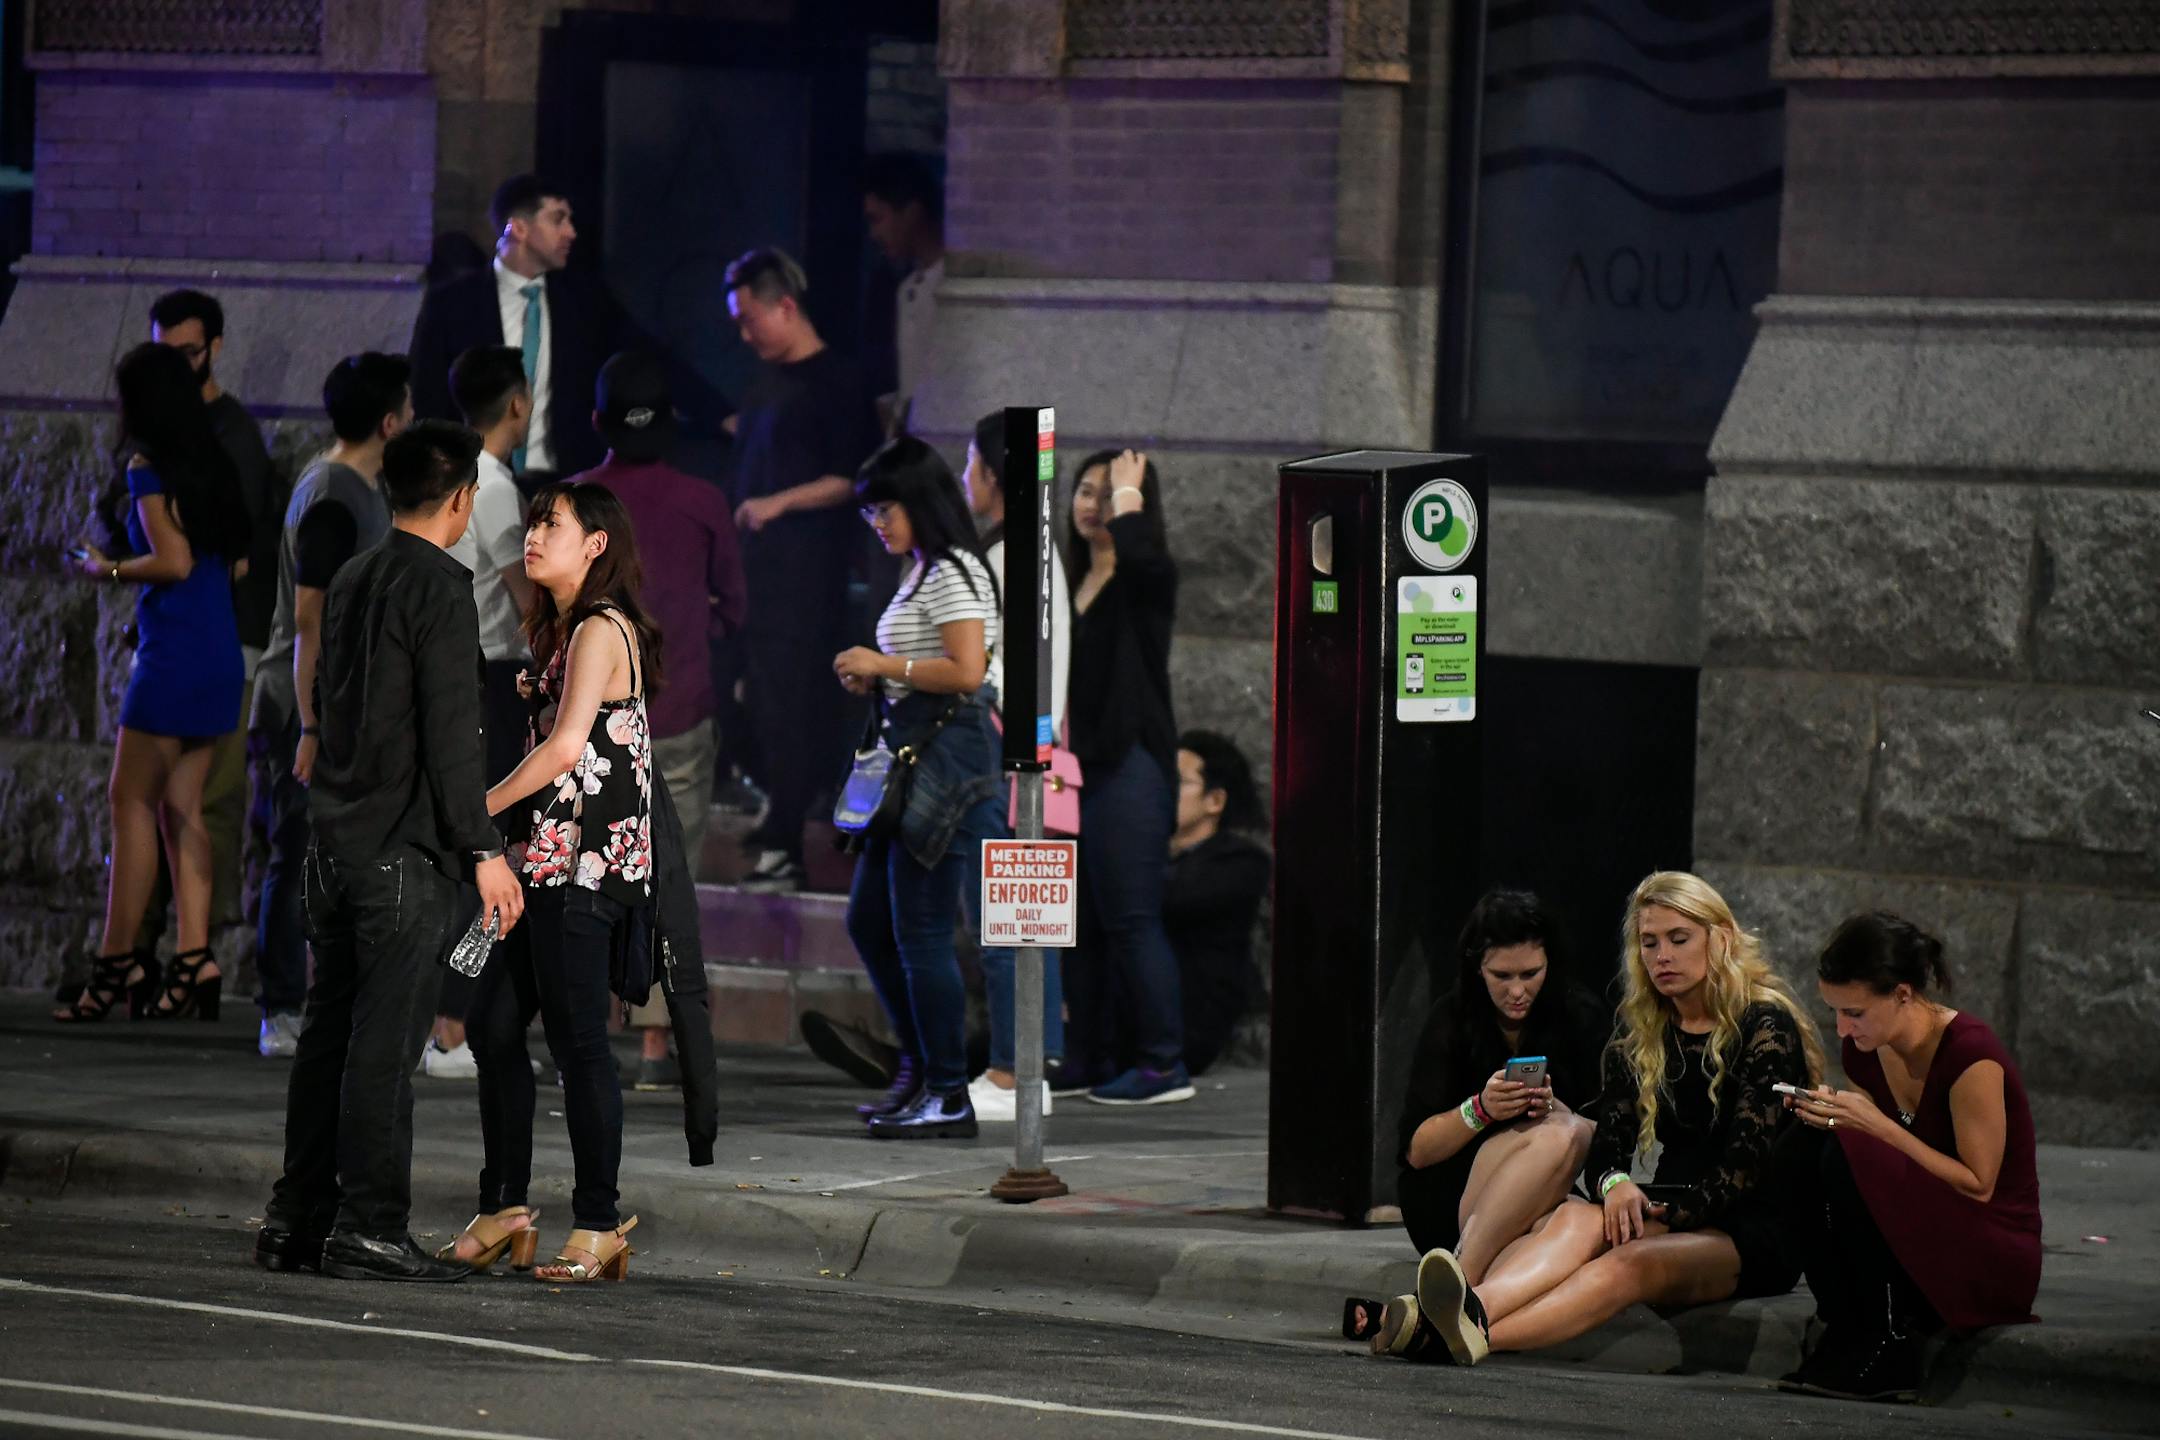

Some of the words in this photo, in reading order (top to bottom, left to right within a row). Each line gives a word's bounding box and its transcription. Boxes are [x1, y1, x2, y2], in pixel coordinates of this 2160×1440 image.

[1423, 502, 1446, 537] P
[990, 848, 1069, 862] METERED
[992, 863, 1066, 877] PARKING
[989, 883, 1069, 904] ENFORCED
[1015, 908, 1042, 921] DAILY
[989, 922, 1017, 935] UNTIL
[1021, 923, 1069, 936] MIDNIGHT
